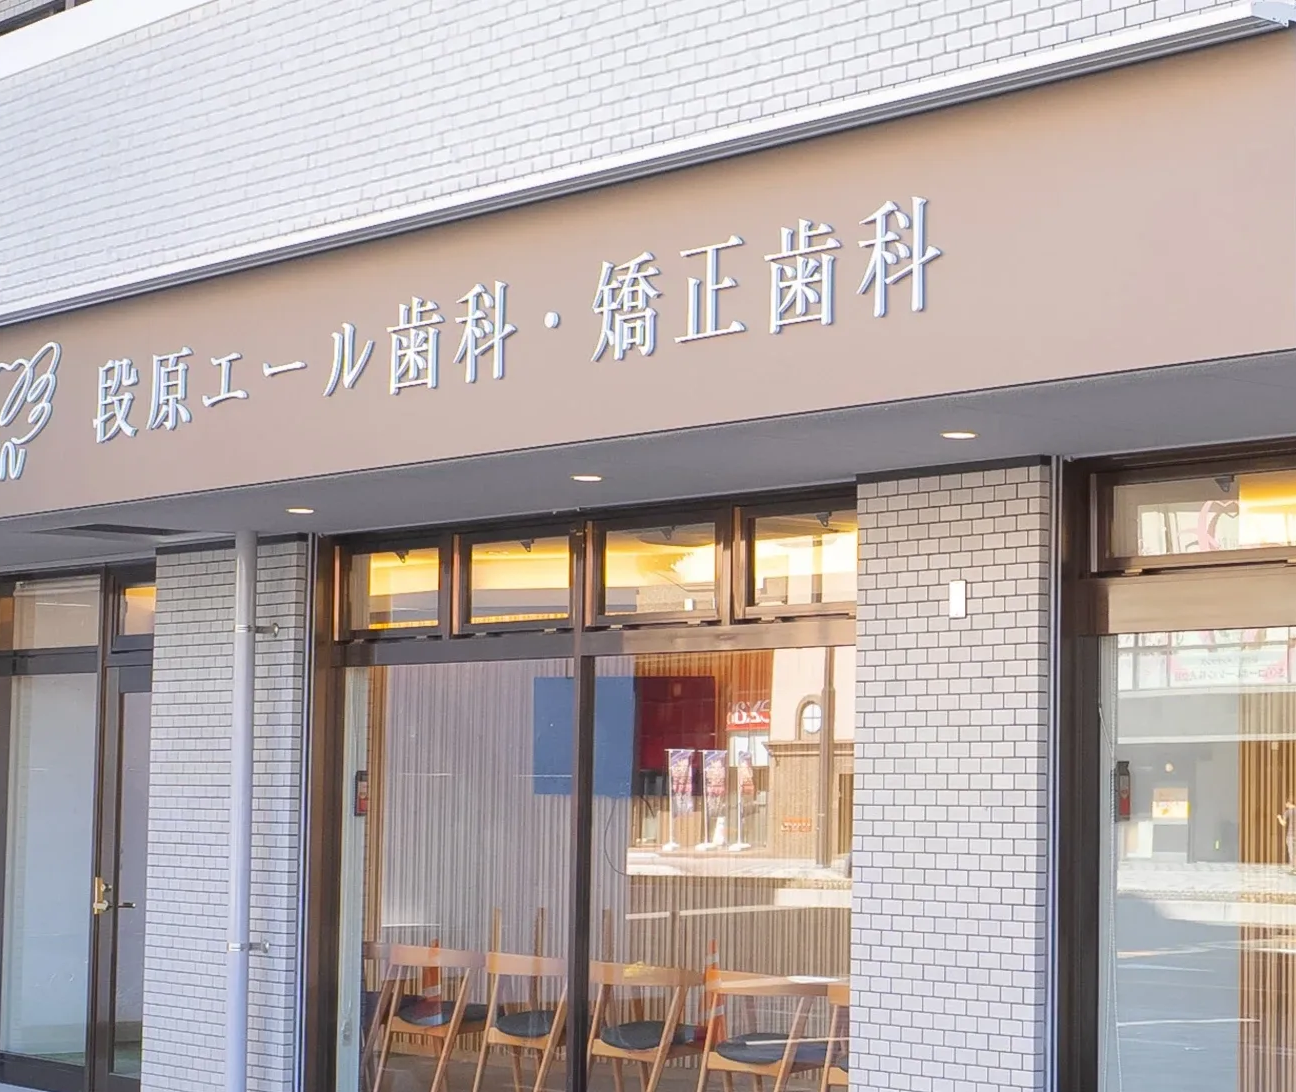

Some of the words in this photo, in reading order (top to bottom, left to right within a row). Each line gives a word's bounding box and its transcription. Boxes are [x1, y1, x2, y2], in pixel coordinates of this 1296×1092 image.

[92, 195, 941, 445] 段原エール歯科・矯正歯科
